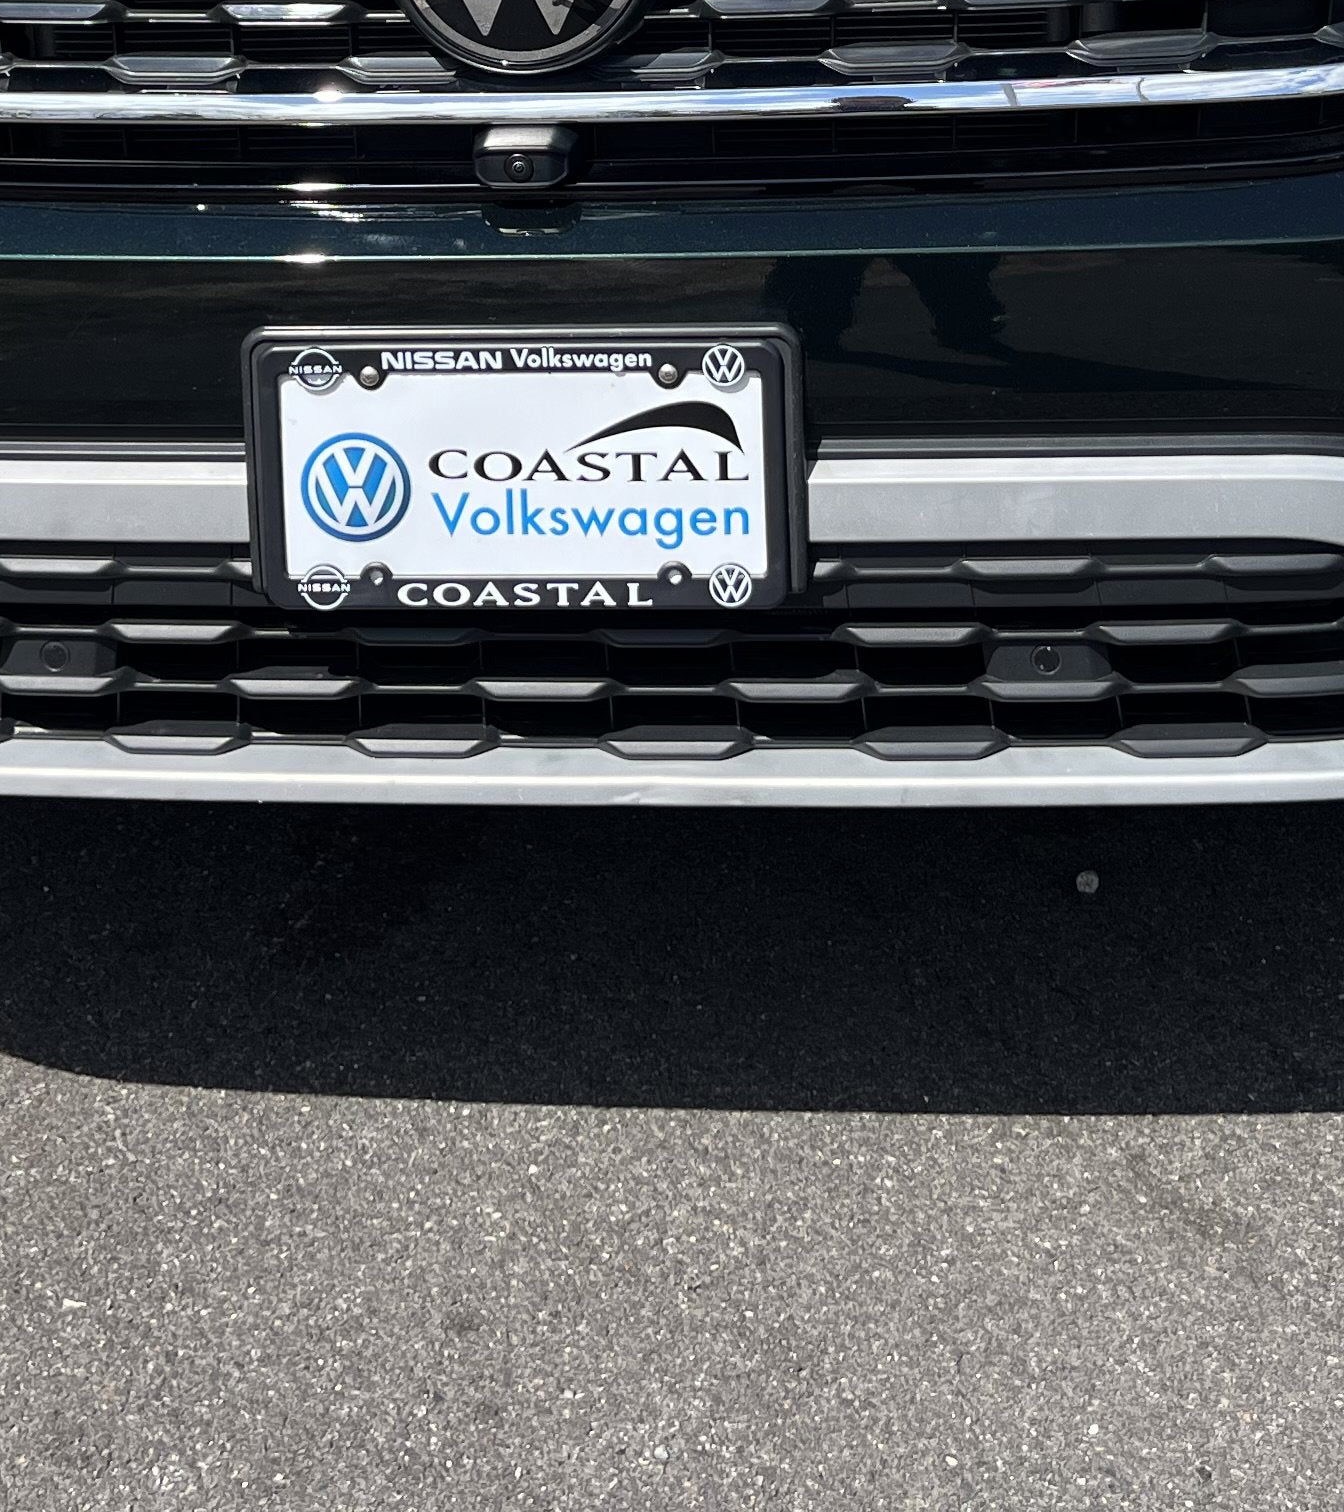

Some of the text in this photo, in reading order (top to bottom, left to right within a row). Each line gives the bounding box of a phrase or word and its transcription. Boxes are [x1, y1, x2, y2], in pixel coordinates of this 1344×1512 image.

[288, 364, 343, 375] NISSAN
[381, 347, 653, 371] NISSAN Volkswagen
[428, 448, 749, 482] COASTAL
[431, 488, 749, 550] Volkswagen
[297, 582, 350, 593] NISSAN
[397, 581, 653, 607] COASTAL
